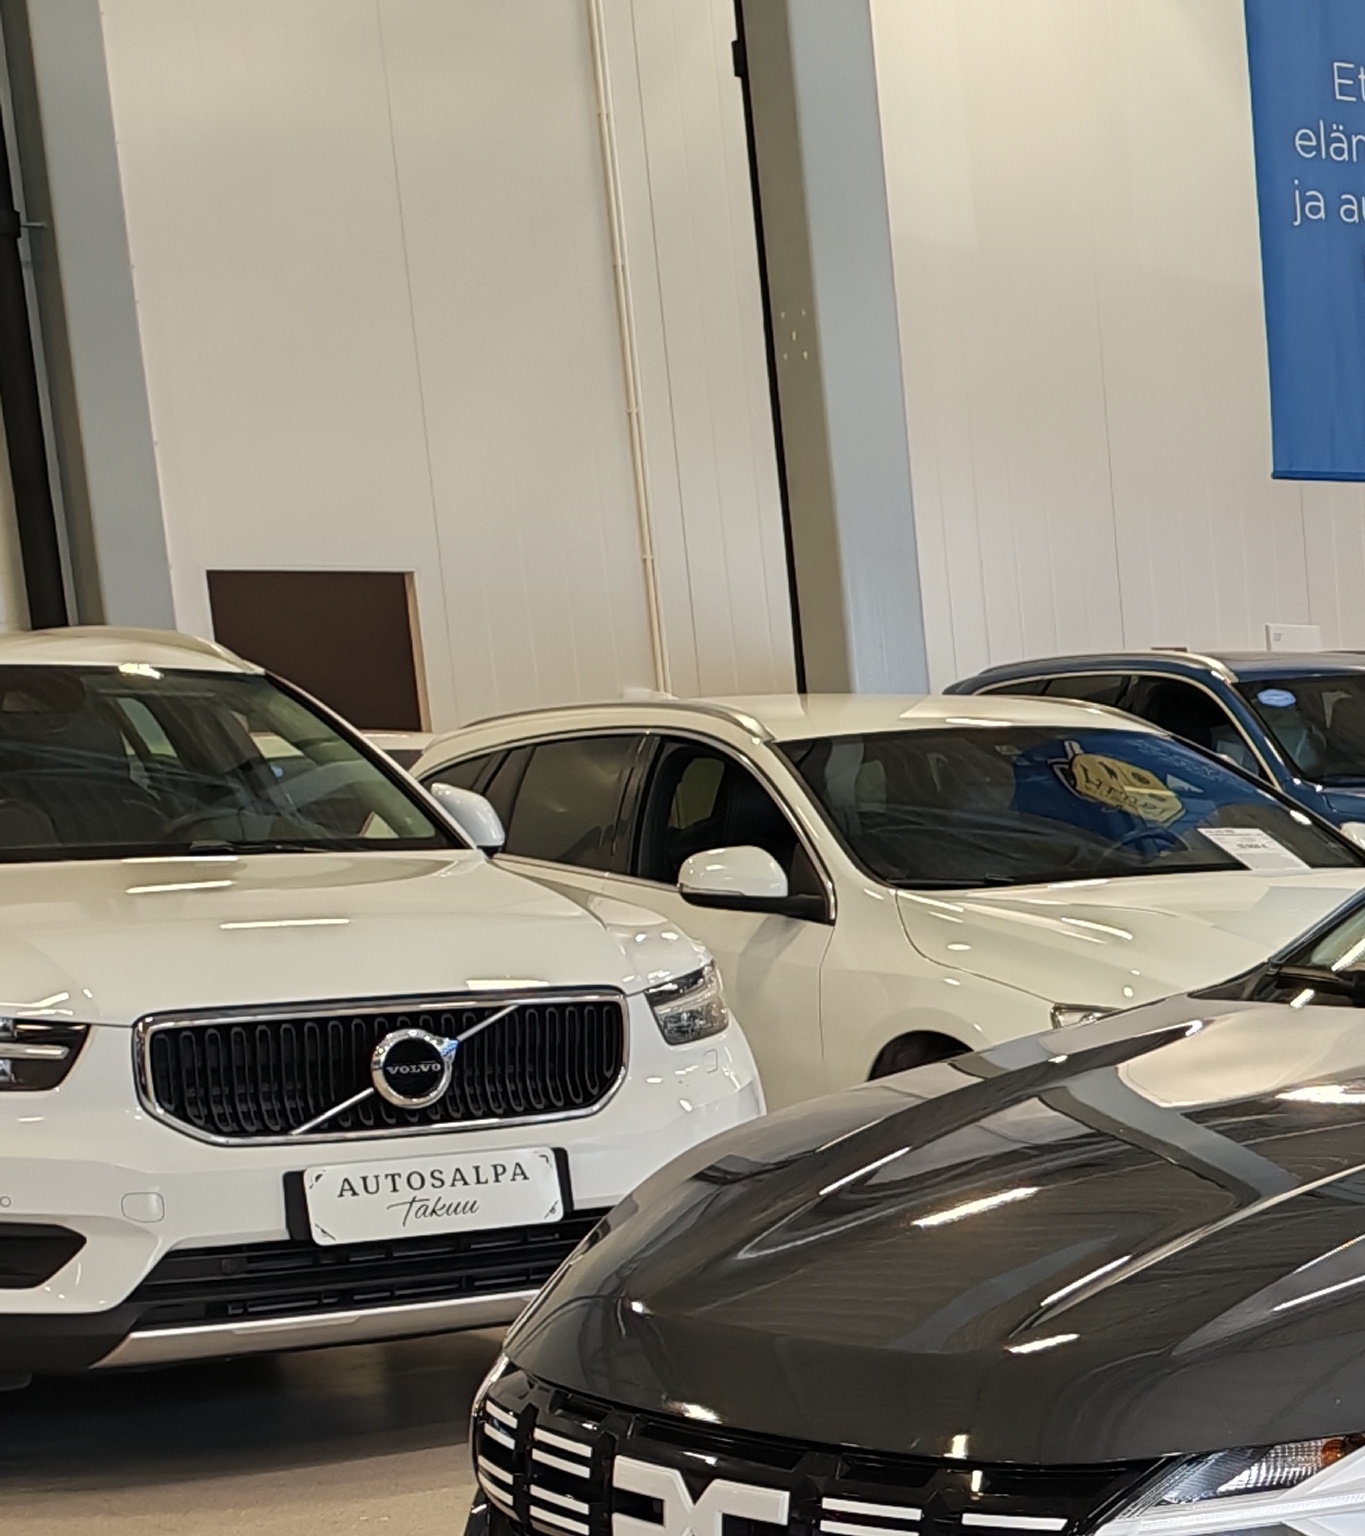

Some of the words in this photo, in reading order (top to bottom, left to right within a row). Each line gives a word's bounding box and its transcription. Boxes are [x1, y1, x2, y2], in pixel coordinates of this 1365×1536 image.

[1293, 178, 1326, 227] ja
[386, 1062, 442, 1075] VOLVO
[337, 1161, 530, 1199] AUTOSALPA
[386, 1195, 481, 1228] Takuu
